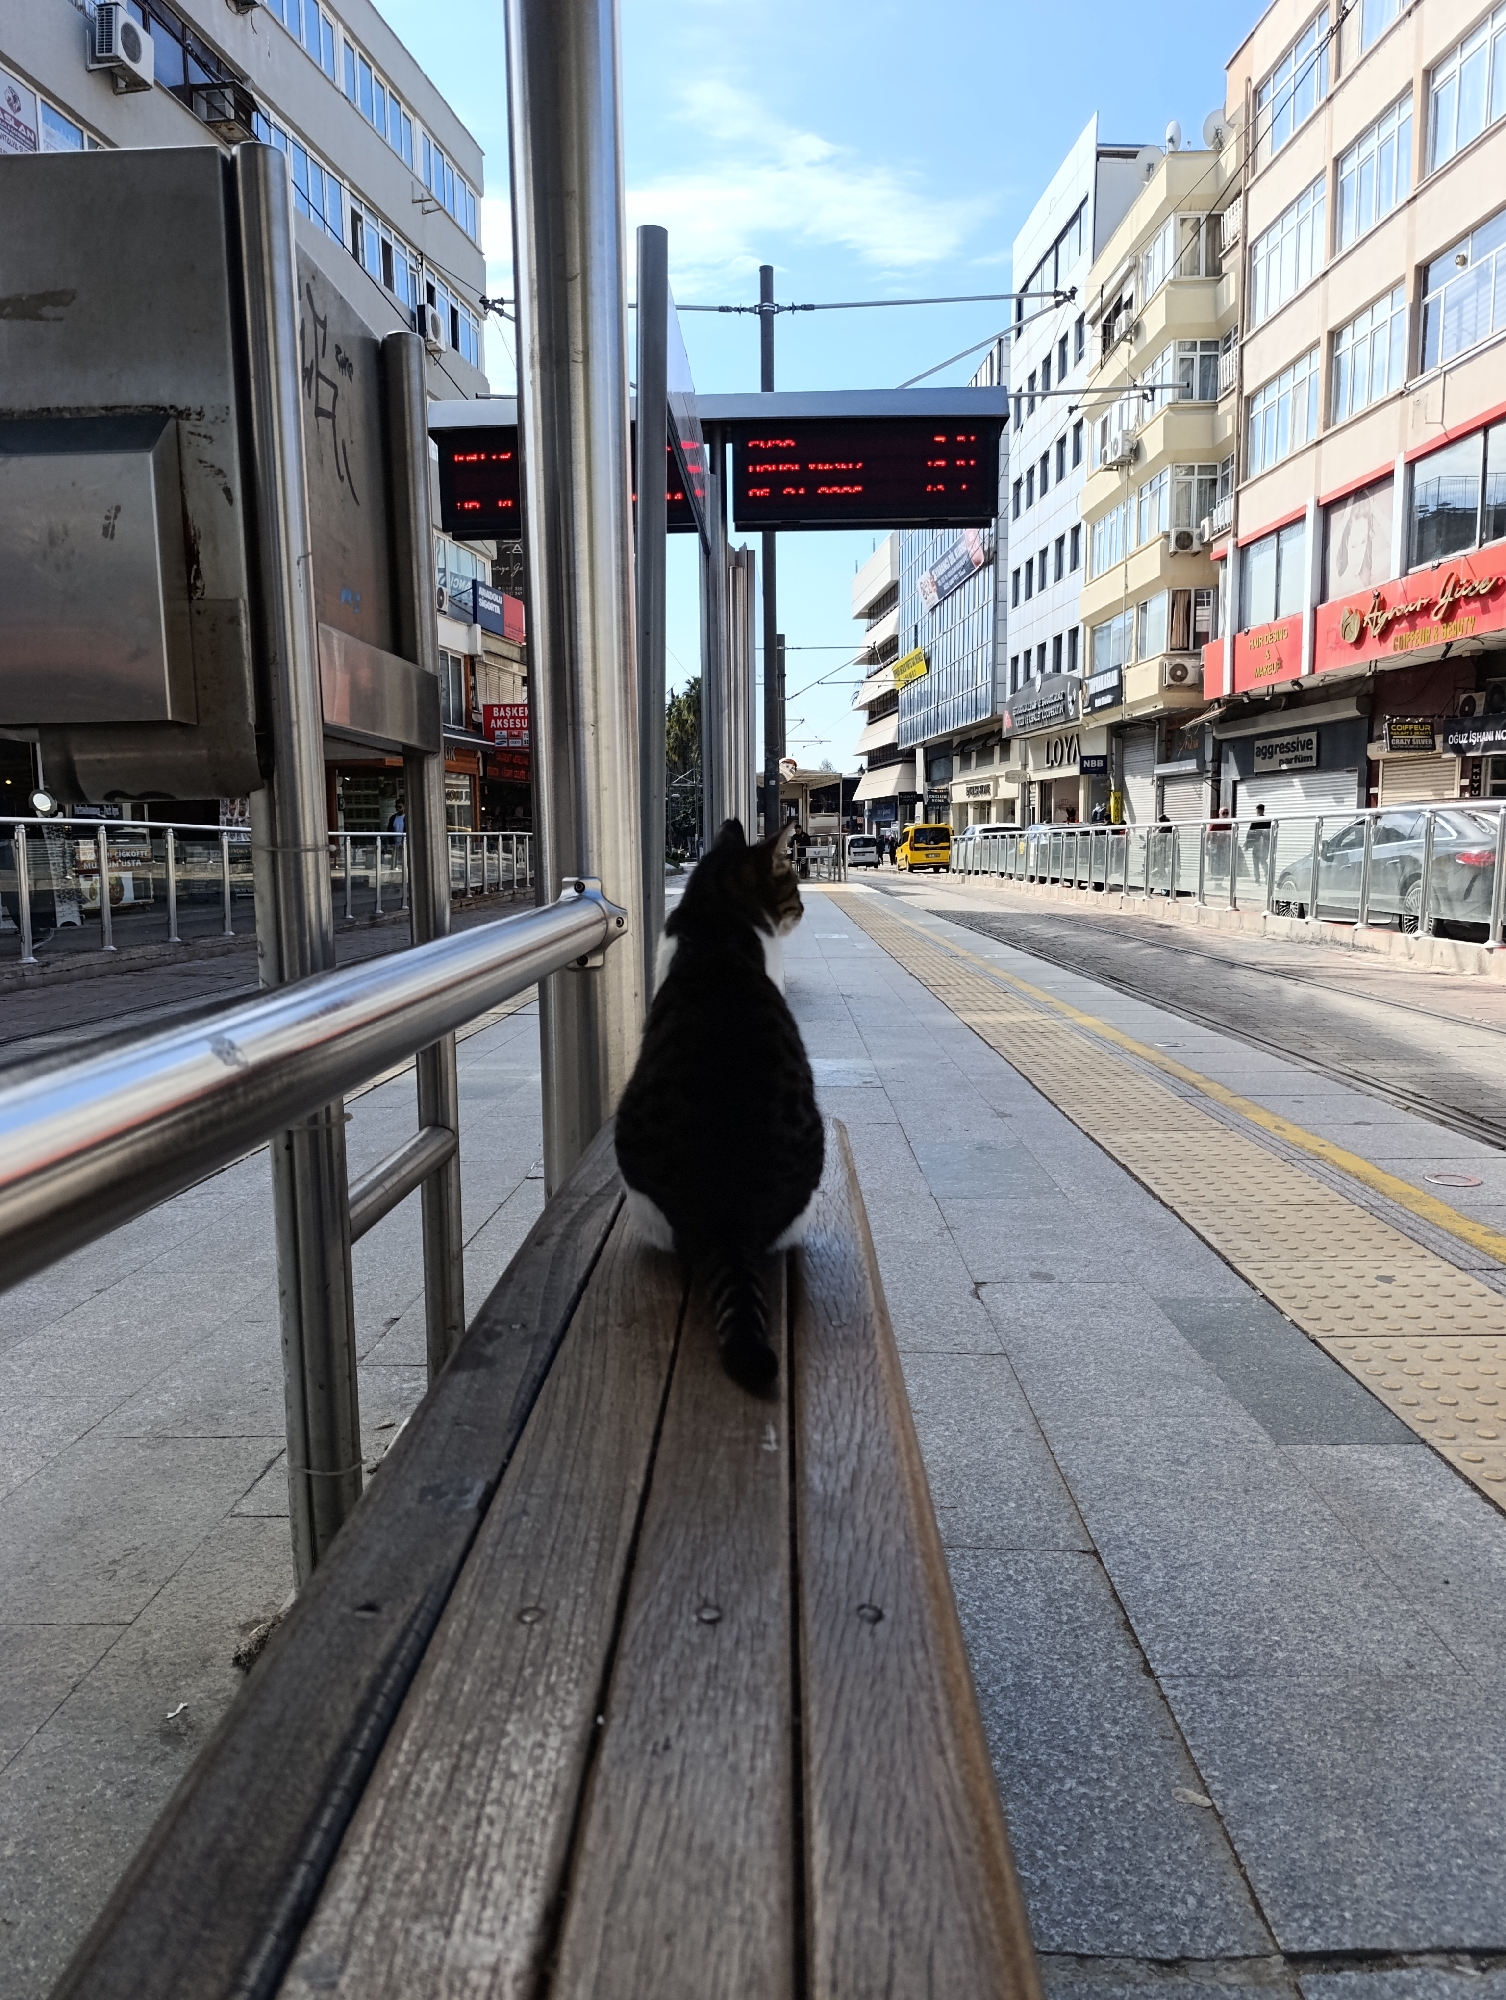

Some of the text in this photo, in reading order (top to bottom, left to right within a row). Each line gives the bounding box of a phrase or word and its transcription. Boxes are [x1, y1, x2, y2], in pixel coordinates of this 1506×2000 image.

[1393, 615, 1476, 651] COIFFEUR & BEAUTY
[1254, 661, 1281, 678] MAKEUP
[1448, 732, 1468, 745] OĞUZ
[1468, 730, 1494, 746] İŞHANI
[1044, 733, 1081, 768] LOYA
[1255, 736, 1314, 760] aggressive
[1083, 759, 1104, 768] NBB
[1278, 754, 1314, 768] parfüm
